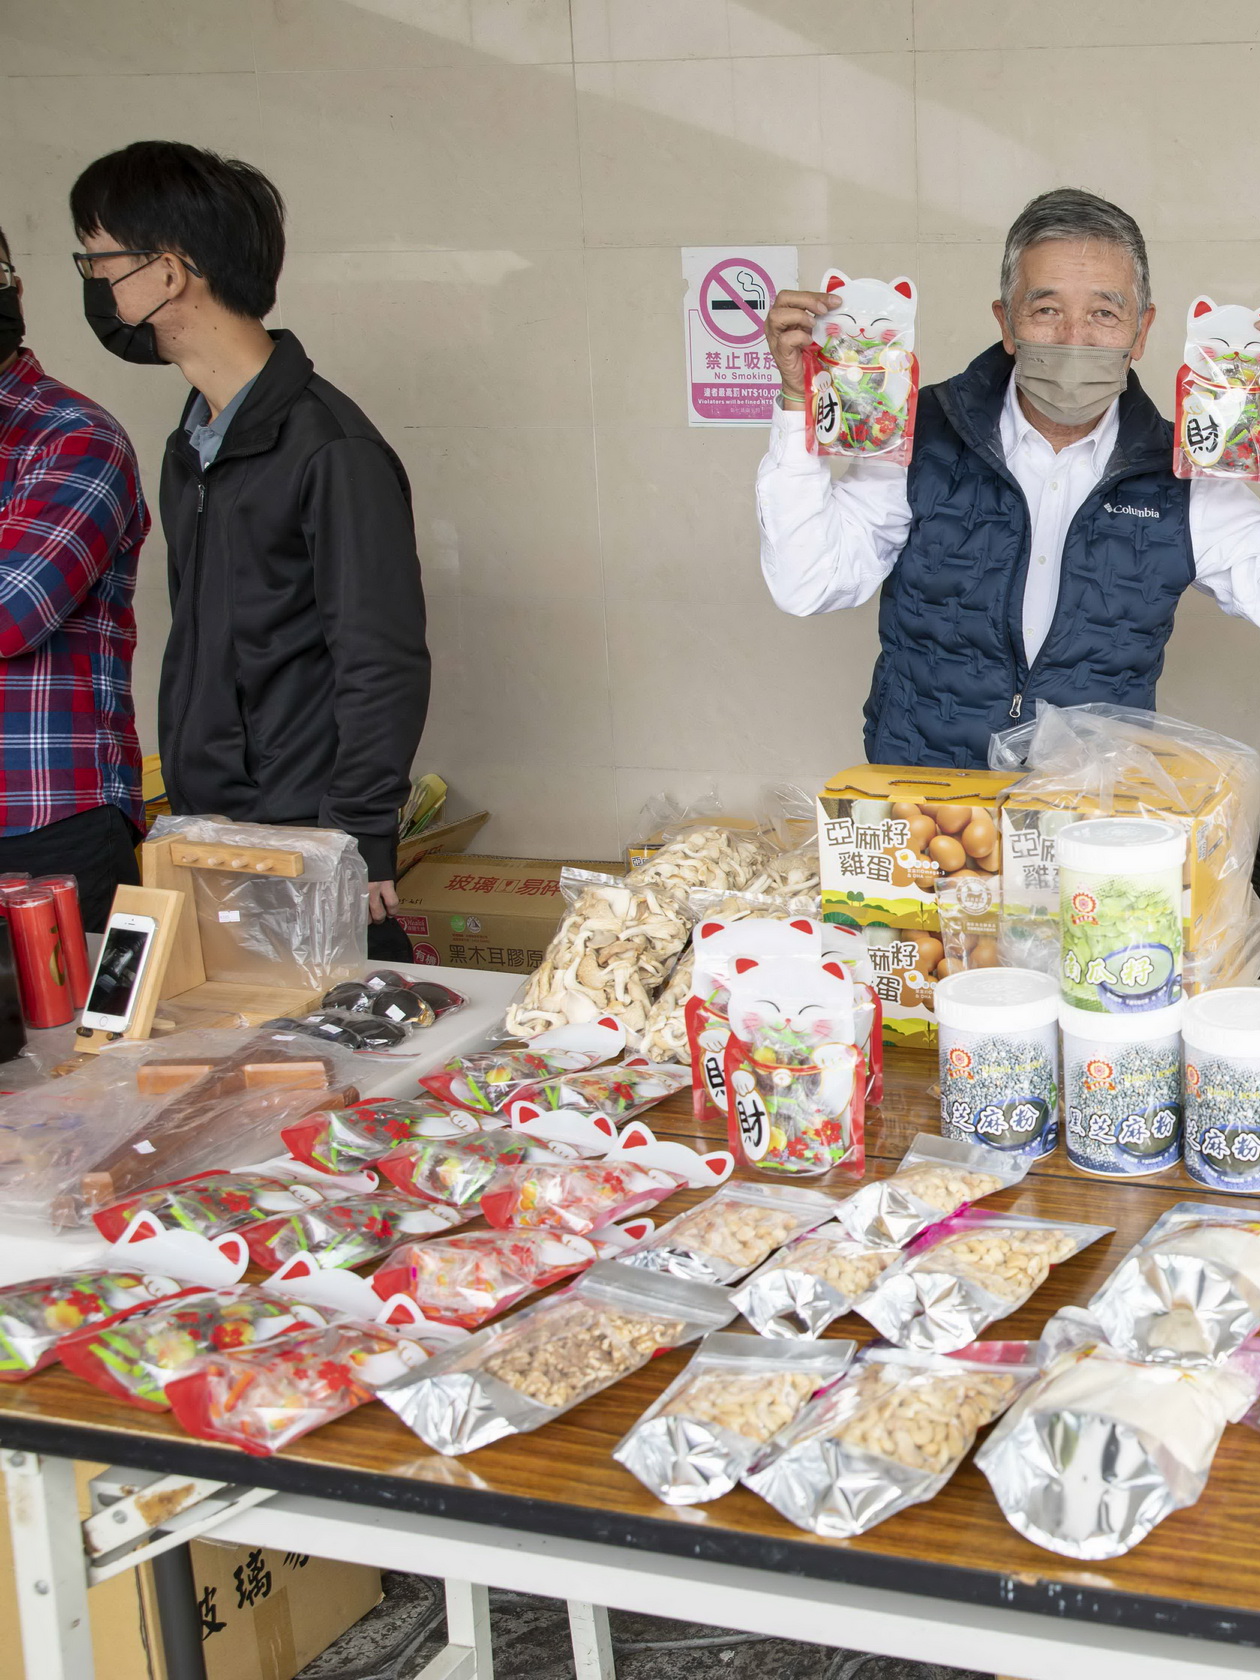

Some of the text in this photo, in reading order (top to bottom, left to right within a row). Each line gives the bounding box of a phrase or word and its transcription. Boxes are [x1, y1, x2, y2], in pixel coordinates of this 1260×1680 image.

[705, 351, 778, 370] 禁止吸菸
[714, 371, 772, 382] No Smoking
[741, 388, 781, 398] NT$10,00
[815, 392, 839, 434] 財
[1186, 414, 1220, 454] 財
[1112, 503, 1160, 519] Columbia
[824, 819, 909, 851] 亞麻籽
[1009, 831, 1055, 863] 亞麻
[838, 851, 892, 883] 雞蛋
[444, 874, 562, 897] 玻璃 易碎
[449, 944, 543, 968] 黑木耳膠原
[867, 943, 917, 972] 麻籽
[876, 974, 900, 1003] 蛋
[737, 1100, 766, 1147] 財
[1069, 1105, 1177, 1145] 黑芝麻粉
